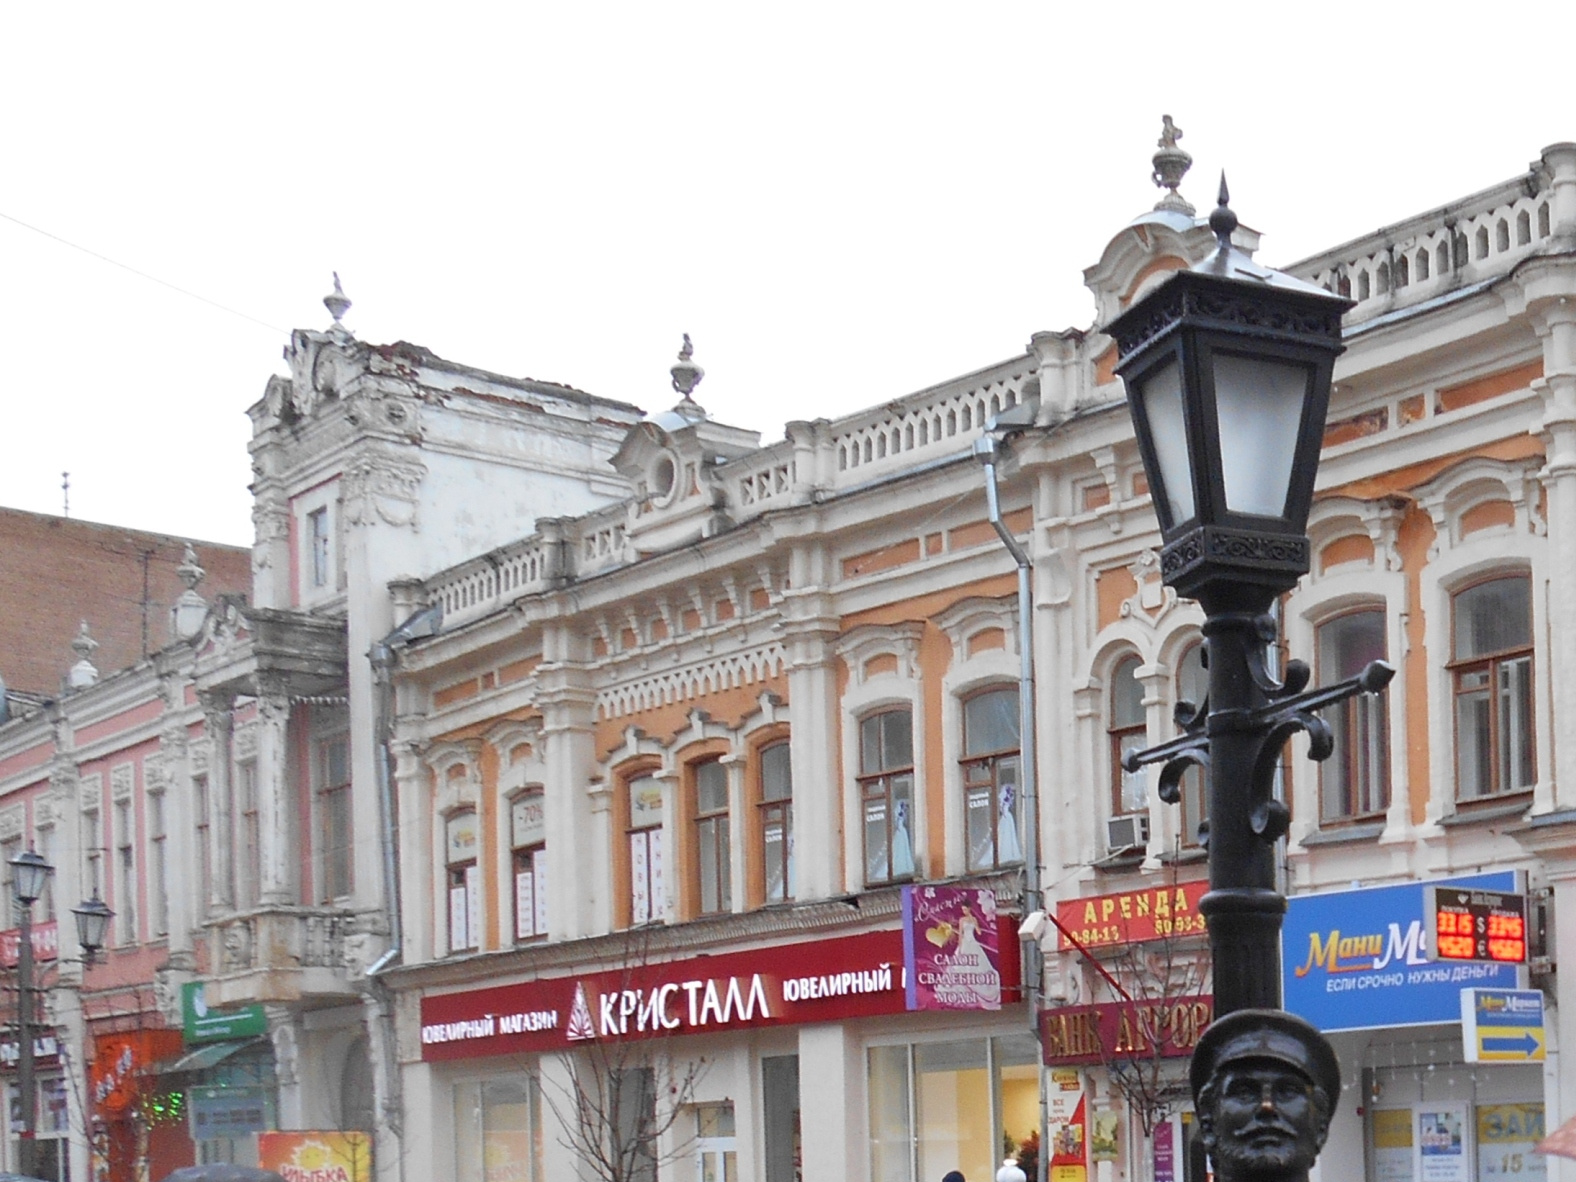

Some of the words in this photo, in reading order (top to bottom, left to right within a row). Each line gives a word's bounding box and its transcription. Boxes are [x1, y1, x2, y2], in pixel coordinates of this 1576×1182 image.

[1084, 888, 1188, 925] АРЕНДА
[933, 953, 979, 967] САЛОН
[1295, 930, 1383, 978] Мани
[918, 972, 997, 986] СВАДЕБНОЙ
[1326, 976, 1356, 993] ЕСЛИ
[1357, 973, 1403, 990] СРОЧНО
[1407, 968, 1450, 984] НУЖНЫ
[1451, 964, 1499, 982] ДЕНЬГИ
[422, 1013, 494, 1044] ЮВЕЛИРНЫЙ
[500, 1010, 557, 1034] МАГАЗИН
[600, 972, 770, 1037] КРИСТАЛЛ
[783, 962, 891, 1002] ЮВЕЛИРНЫЙ
[936, 993, 977, 1005] МОДЫ
[1502, 1153, 1523, 1174] 15
